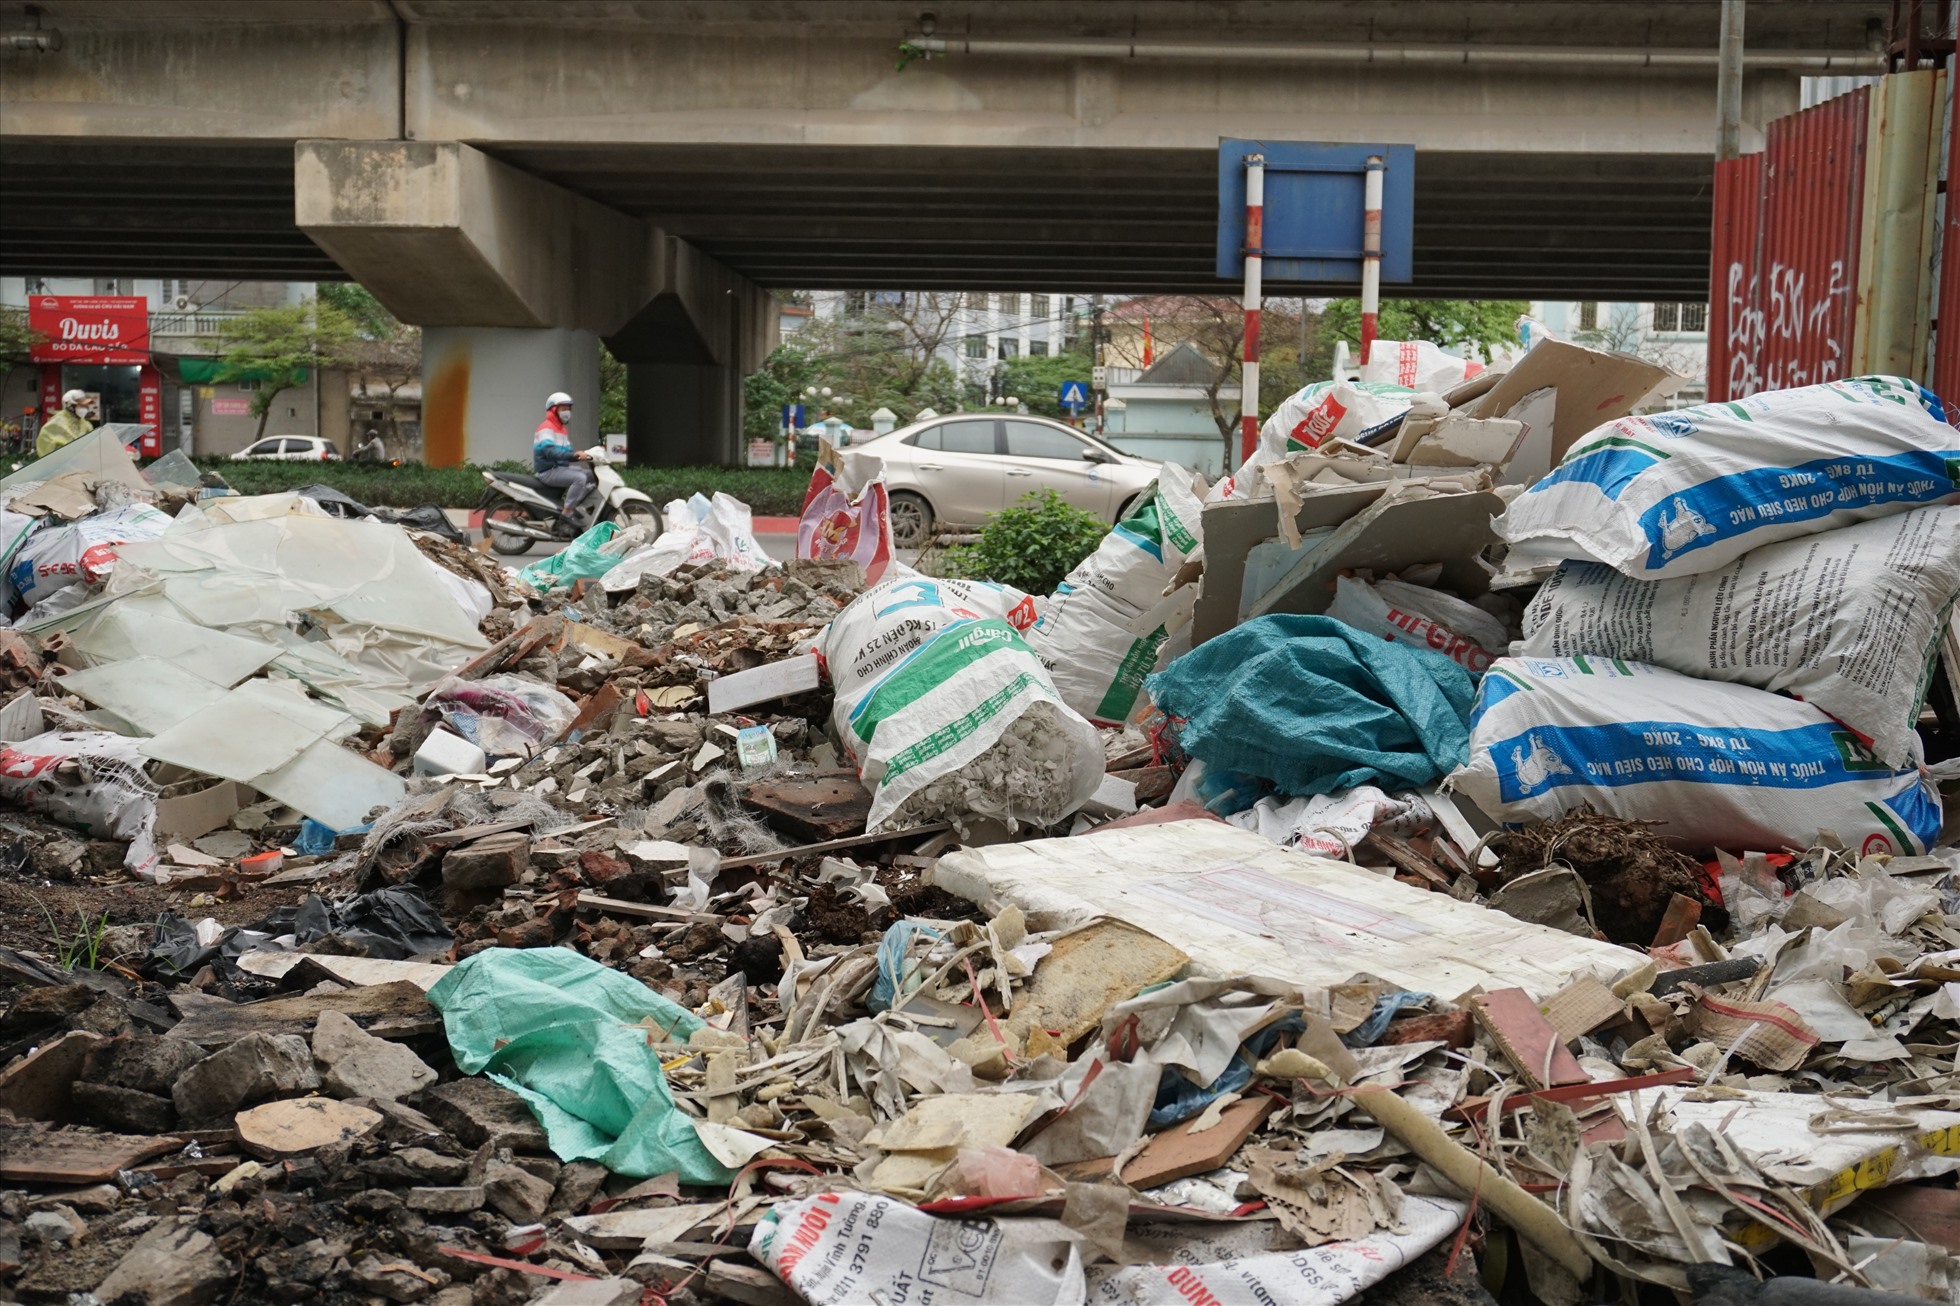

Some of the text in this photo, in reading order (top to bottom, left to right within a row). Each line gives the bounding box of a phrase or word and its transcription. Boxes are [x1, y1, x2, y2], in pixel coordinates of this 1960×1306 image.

[59, 318, 119, 340] Duvis
[1778, 472, 1817, 489] 20KG
[1823, 464, 1851, 480] 8KG
[1810, 490, 1834, 508] CHO
[1907, 480, 1935, 499] THỨC
[1758, 501, 1783, 521] SIÊU
[1784, 496, 1808, 513] HEO
[1729, 504, 1756, 526] NẠC
[958, 625, 1013, 650] Cargill
[857, 658, 877, 678] CHO
[1643, 732, 1683, 747] 20KG
[1588, 758, 1612, 777] NẠC
[1615, 757, 1644, 780] SIÊU
[1647, 757, 1674, 771] HEO
[1677, 757, 1705, 771] CHO
[1791, 760, 1826, 784] THỨC
[791, 1205, 832, 1251] NUÔI
[850, 1233, 874, 1274] 3791
[866, 1201, 889, 1229] 880
